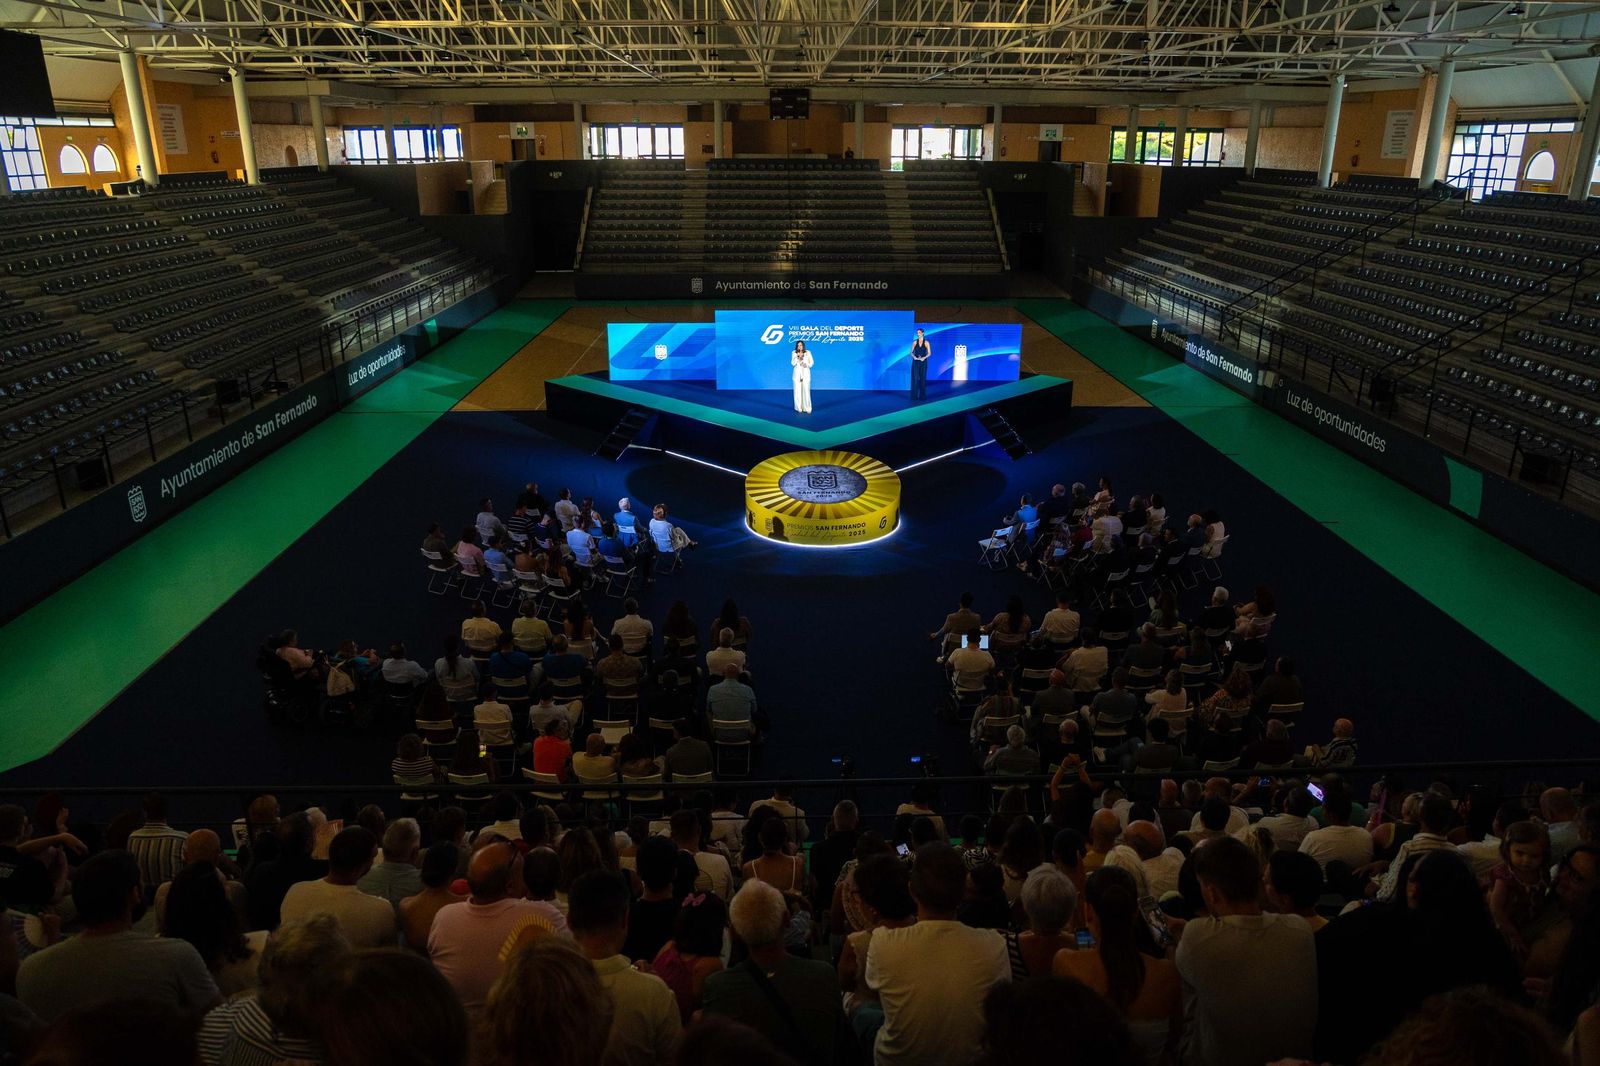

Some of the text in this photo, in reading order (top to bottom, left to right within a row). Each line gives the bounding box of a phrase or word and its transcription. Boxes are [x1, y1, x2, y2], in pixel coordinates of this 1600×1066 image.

[715, 280, 889, 292] Ayuntamiento de San Fernando
[347, 344, 406, 386] Luz de oportunidades
[1197, 345, 1206, 359] de
[1205, 349, 1218, 367] San
[1218, 354, 1253, 384] Fernando
[1286, 389, 1387, 453] Luz de oportunidades
[160, 394, 319, 499] Ayuntamiento de San Fernando
[831, 522, 867, 531] FERNANDO
[848, 529, 867, 537] 2025
